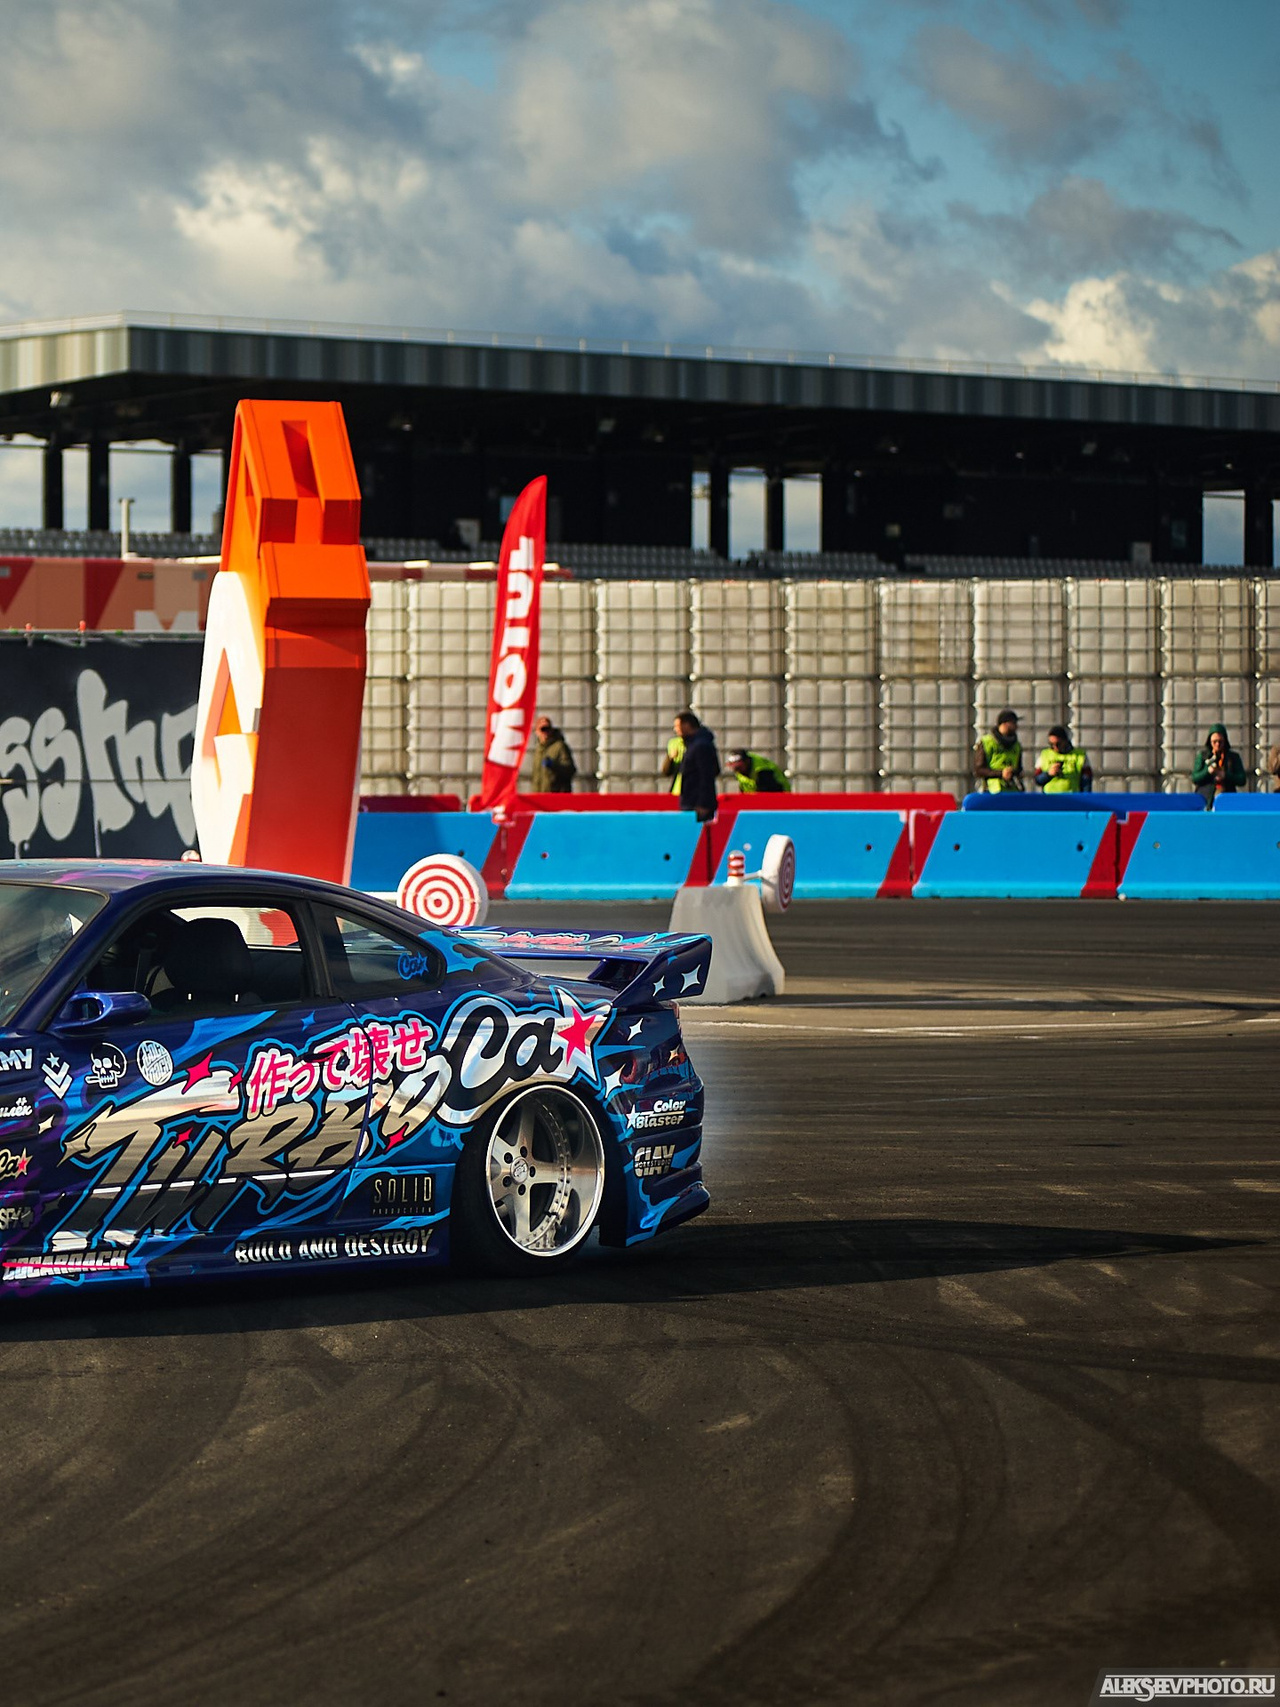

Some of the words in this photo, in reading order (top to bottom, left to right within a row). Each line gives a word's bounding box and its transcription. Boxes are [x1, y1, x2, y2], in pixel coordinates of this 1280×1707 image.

[487, 535, 534, 768] MOTUL
[248, 1017, 434, 1117] 作って壊せ
[654, 1099, 686, 1113] Color
[637, 1115, 684, 1129] Blaster
[374, 1176, 433, 1204] SOLID
[235, 1240, 292, 1264] BUILD
[298, 1237, 338, 1260] AND
[345, 1229, 434, 1257] DESTROY
